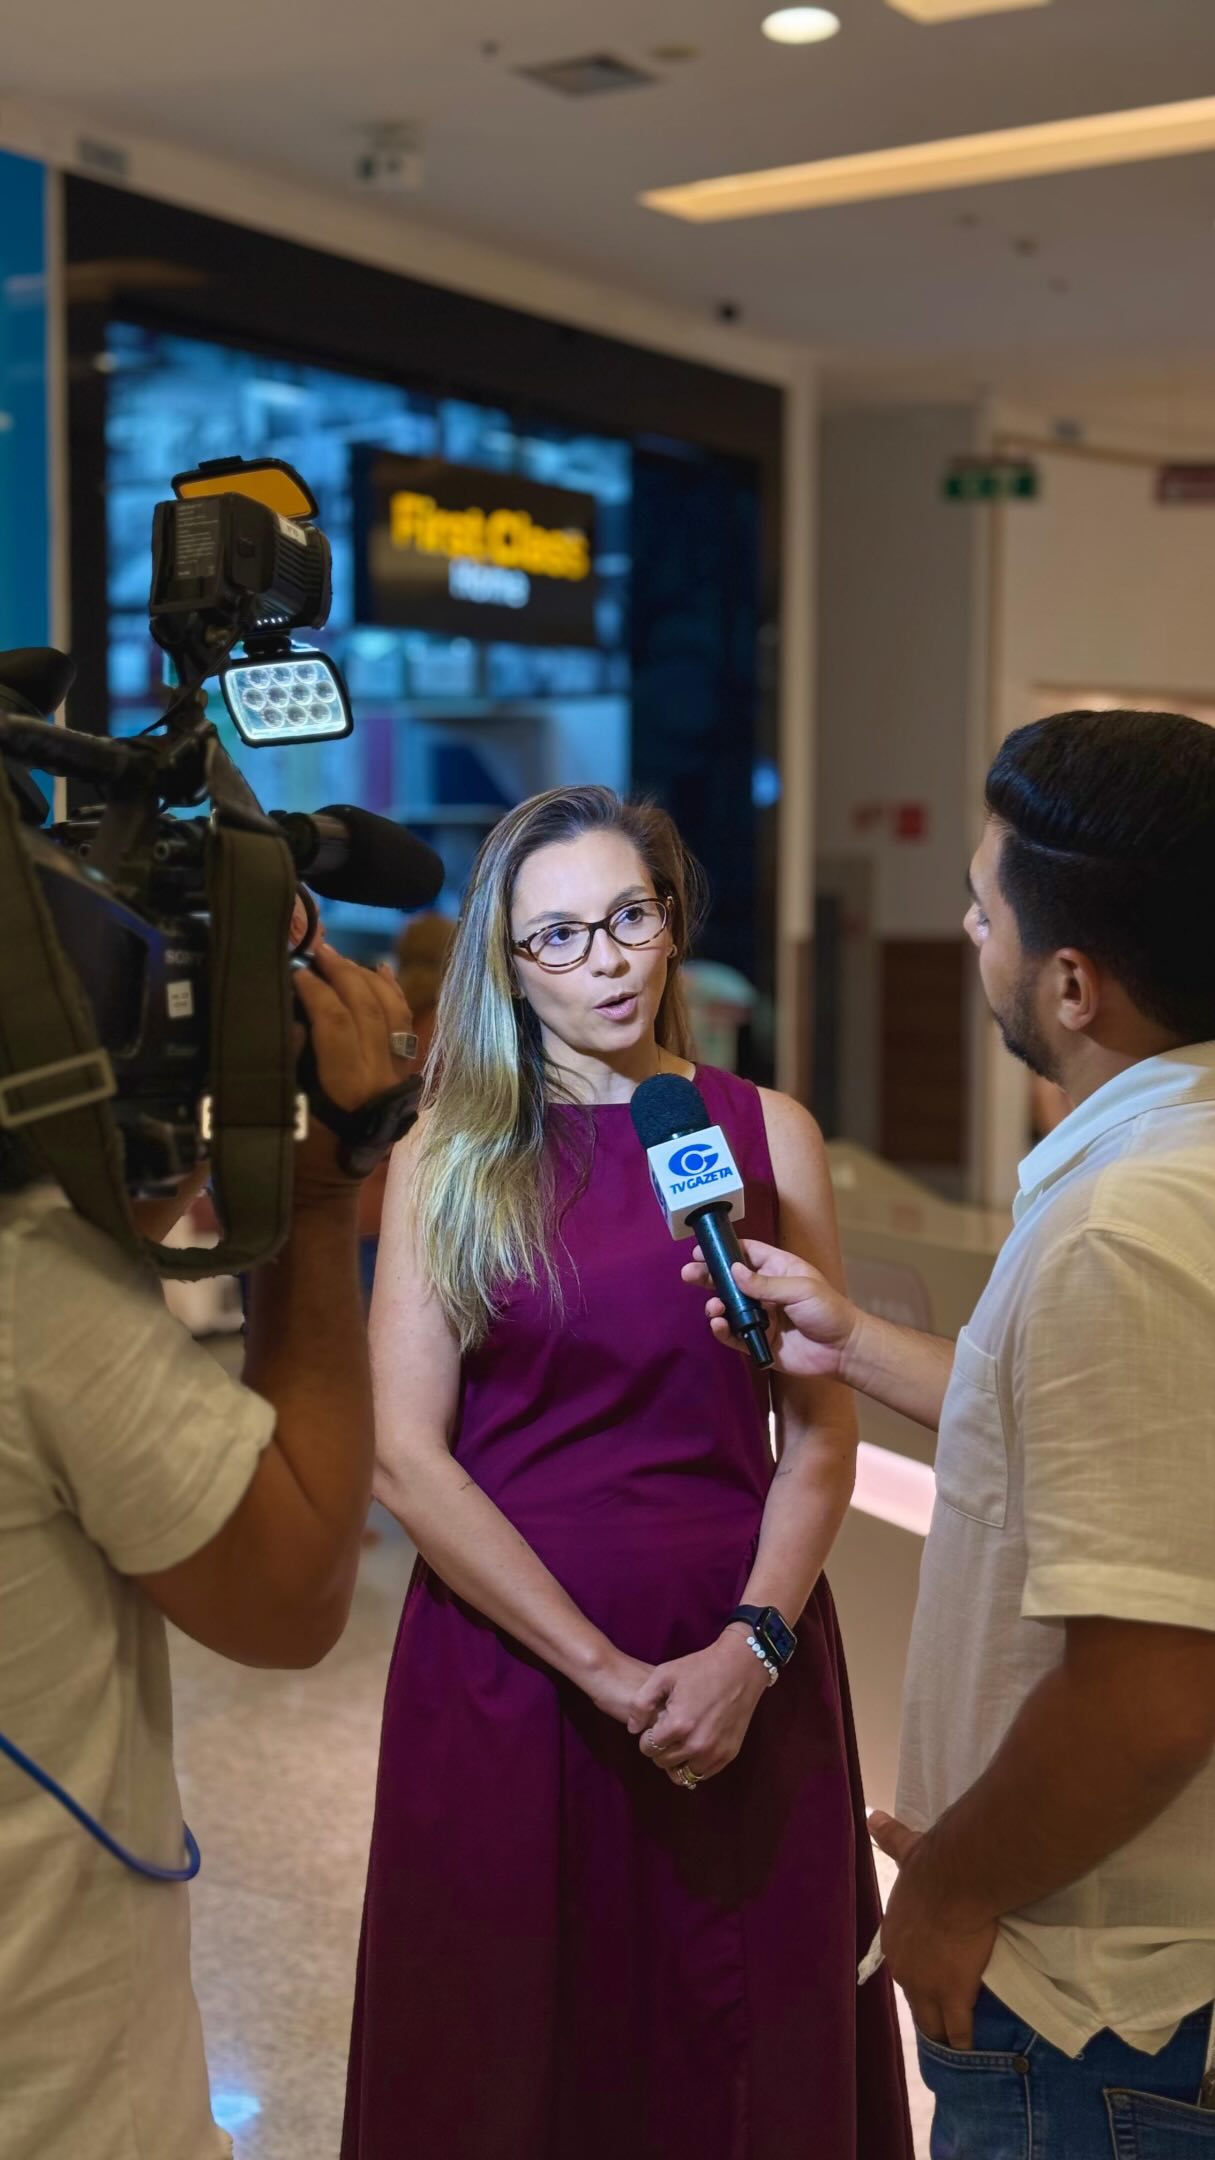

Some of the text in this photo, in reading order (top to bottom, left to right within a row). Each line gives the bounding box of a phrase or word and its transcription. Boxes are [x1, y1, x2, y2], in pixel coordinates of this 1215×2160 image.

[391, 491, 589, 580] First Class
[670, 1167, 733, 1195] TV GAZETA
